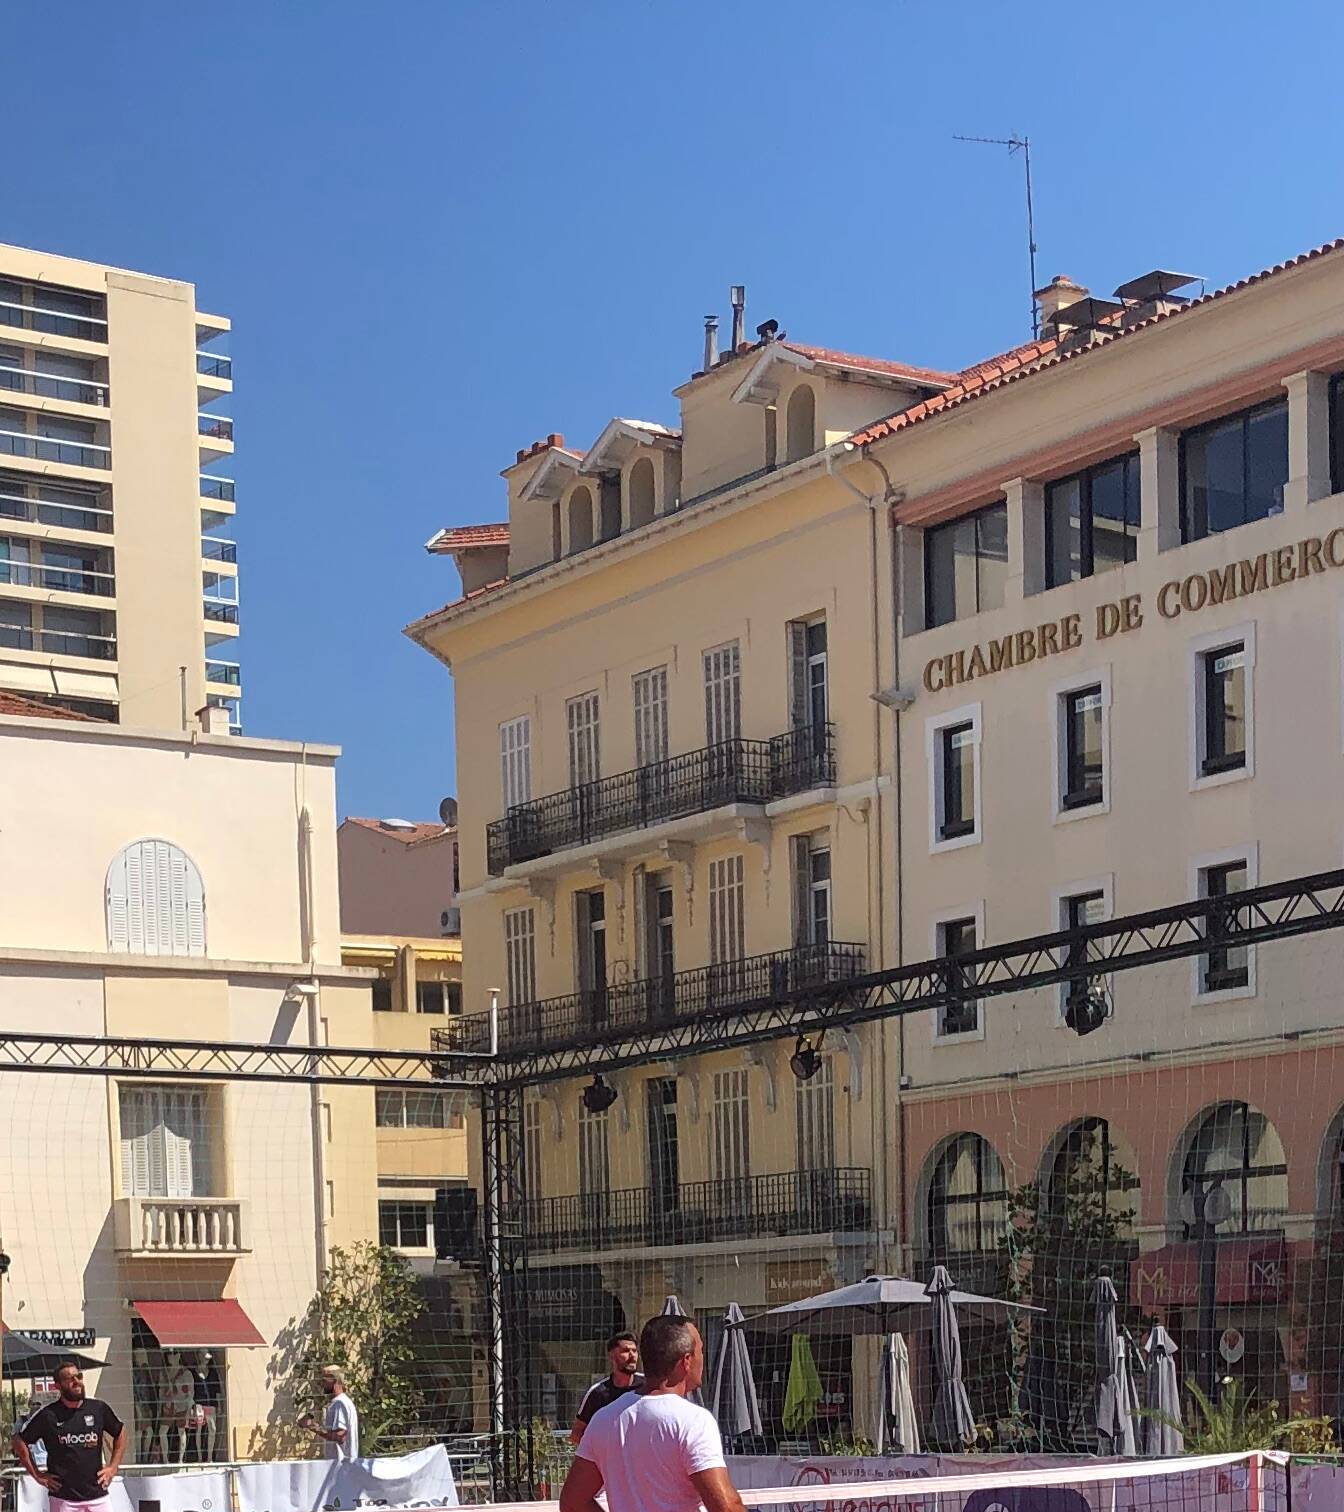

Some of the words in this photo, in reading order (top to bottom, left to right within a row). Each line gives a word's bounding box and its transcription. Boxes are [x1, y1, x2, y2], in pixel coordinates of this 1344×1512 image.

[923, 613, 1083, 693] CHAMBRE
[1096, 594, 1144, 640] DE
[57, 1431, 99, 1445] infocob
